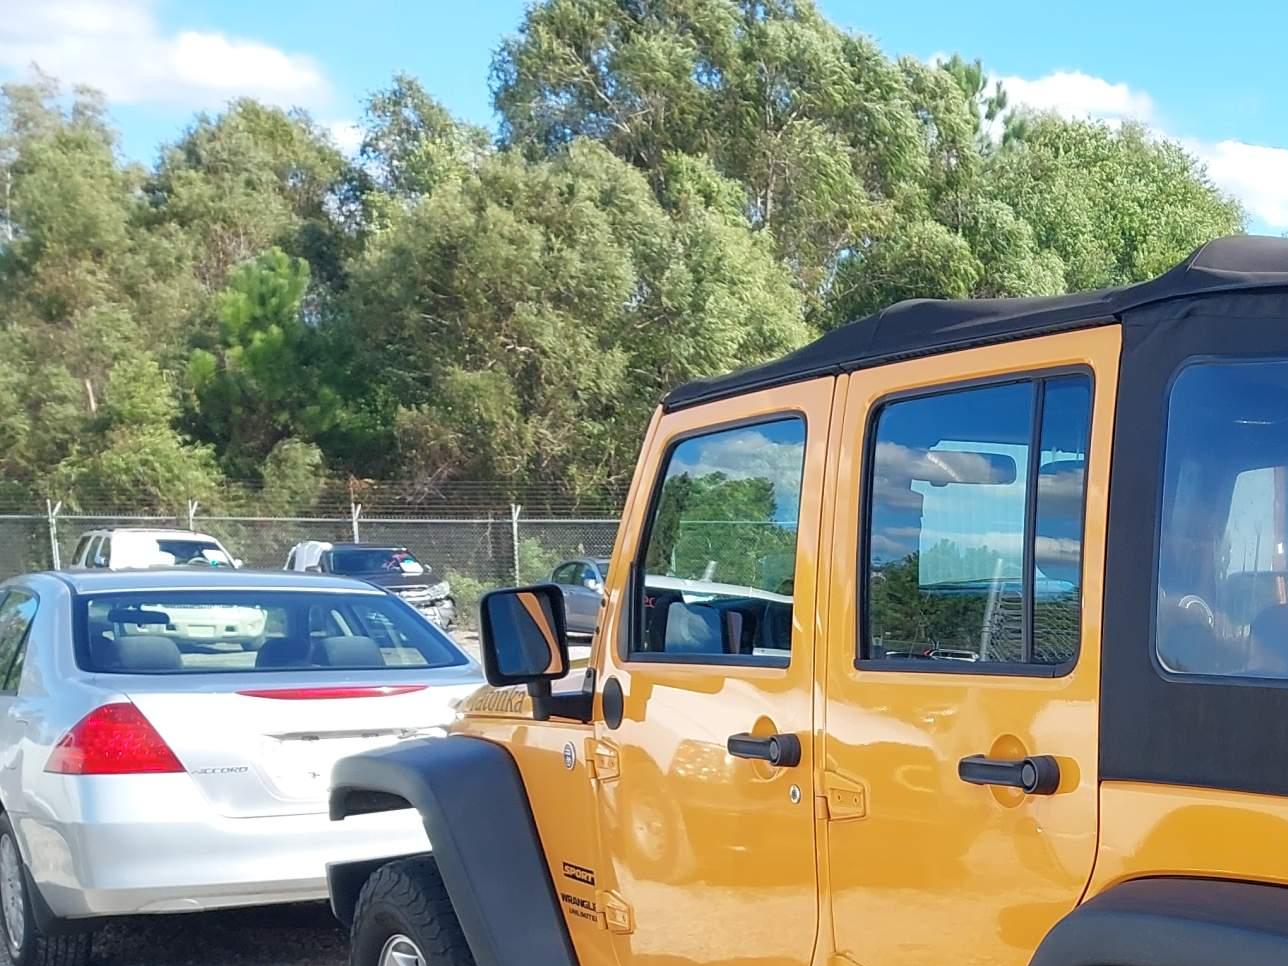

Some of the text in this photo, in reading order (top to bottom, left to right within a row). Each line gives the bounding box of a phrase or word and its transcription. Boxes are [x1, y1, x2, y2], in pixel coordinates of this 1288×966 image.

[190, 766, 249, 775] ACCORD
[563, 864, 594, 883] SPORT
[560, 893, 597, 912] WRANGLE
